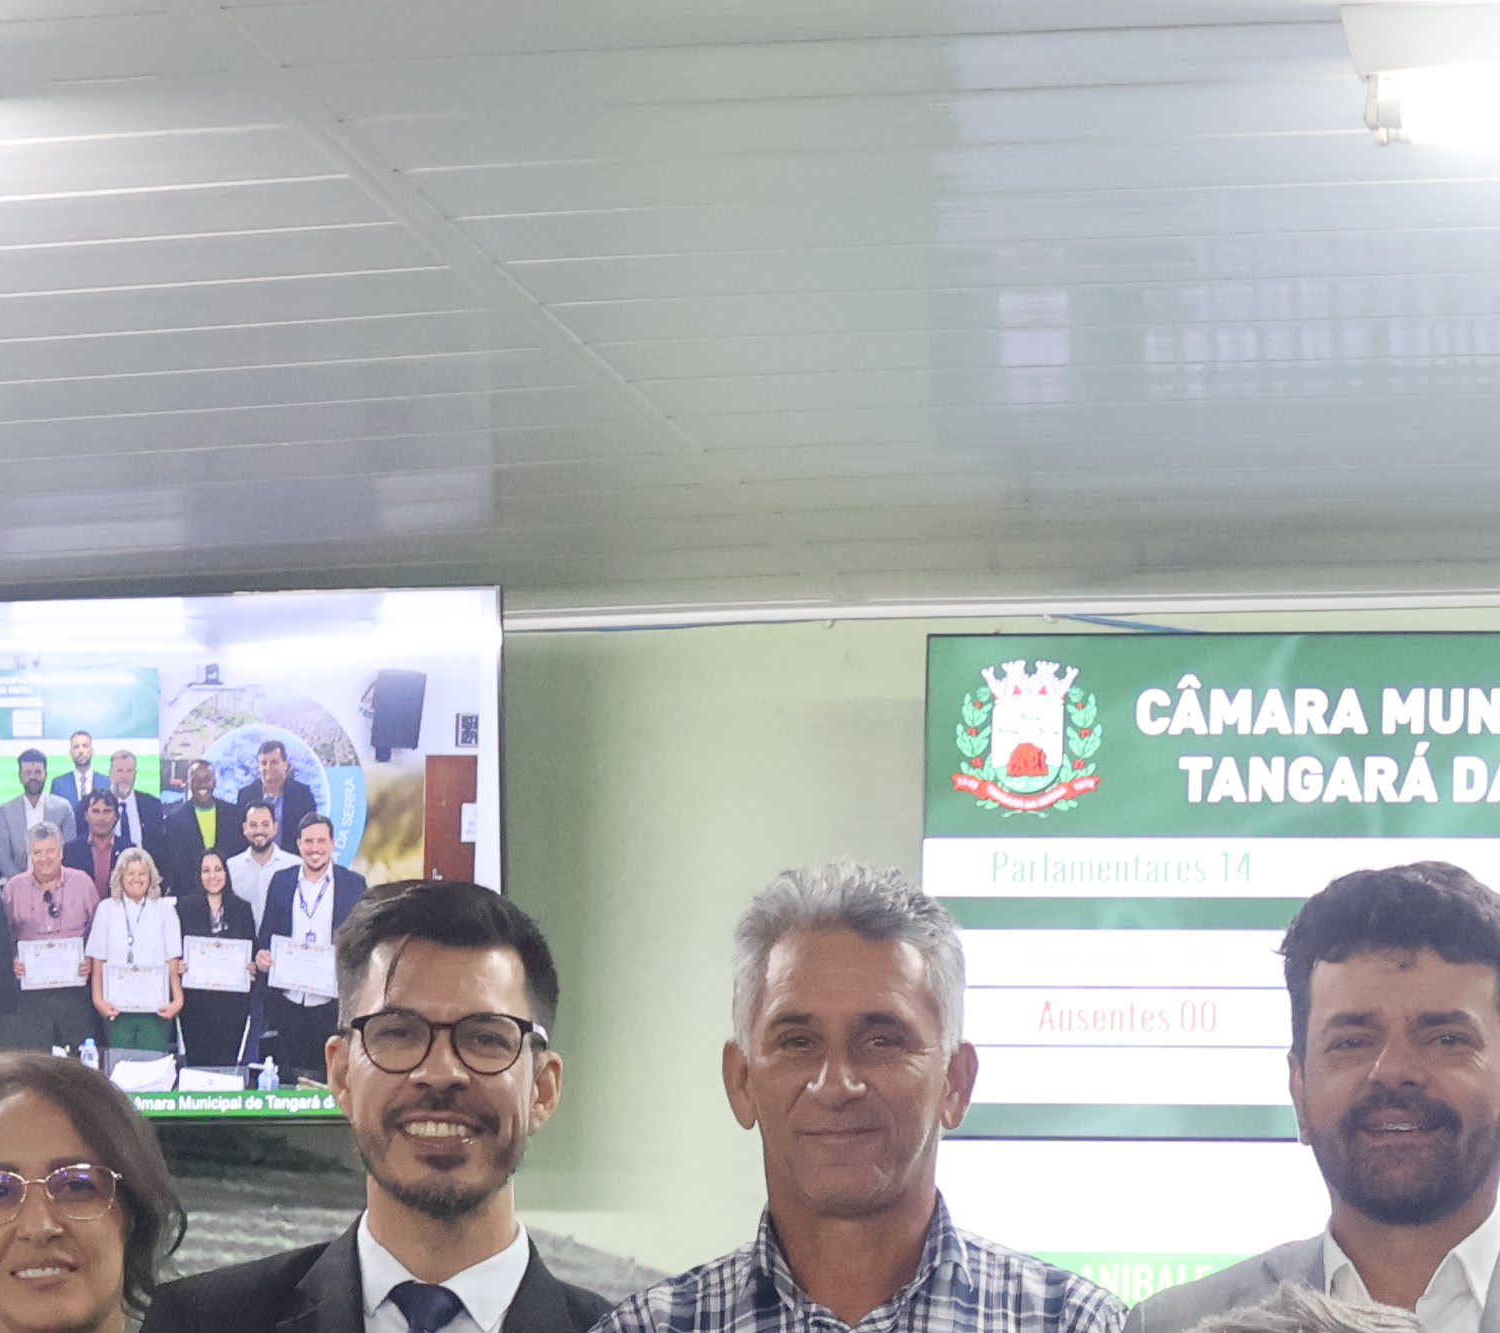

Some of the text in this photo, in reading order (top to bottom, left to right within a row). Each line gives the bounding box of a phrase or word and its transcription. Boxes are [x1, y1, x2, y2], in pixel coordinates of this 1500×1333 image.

[1135, 675, 1367, 735] CÂMARA
[1178, 742, 1437, 803] TANGARÁ
[342, 775, 356, 828] SERRA
[993, 849, 1253, 884] Parlamentares 14
[1038, 999, 1217, 1032] Ausentes 00
[179, 1095, 242, 1112] Municipal
[245, 1095, 262, 1109] de
[265, 1094, 320, 1112] Tangará
